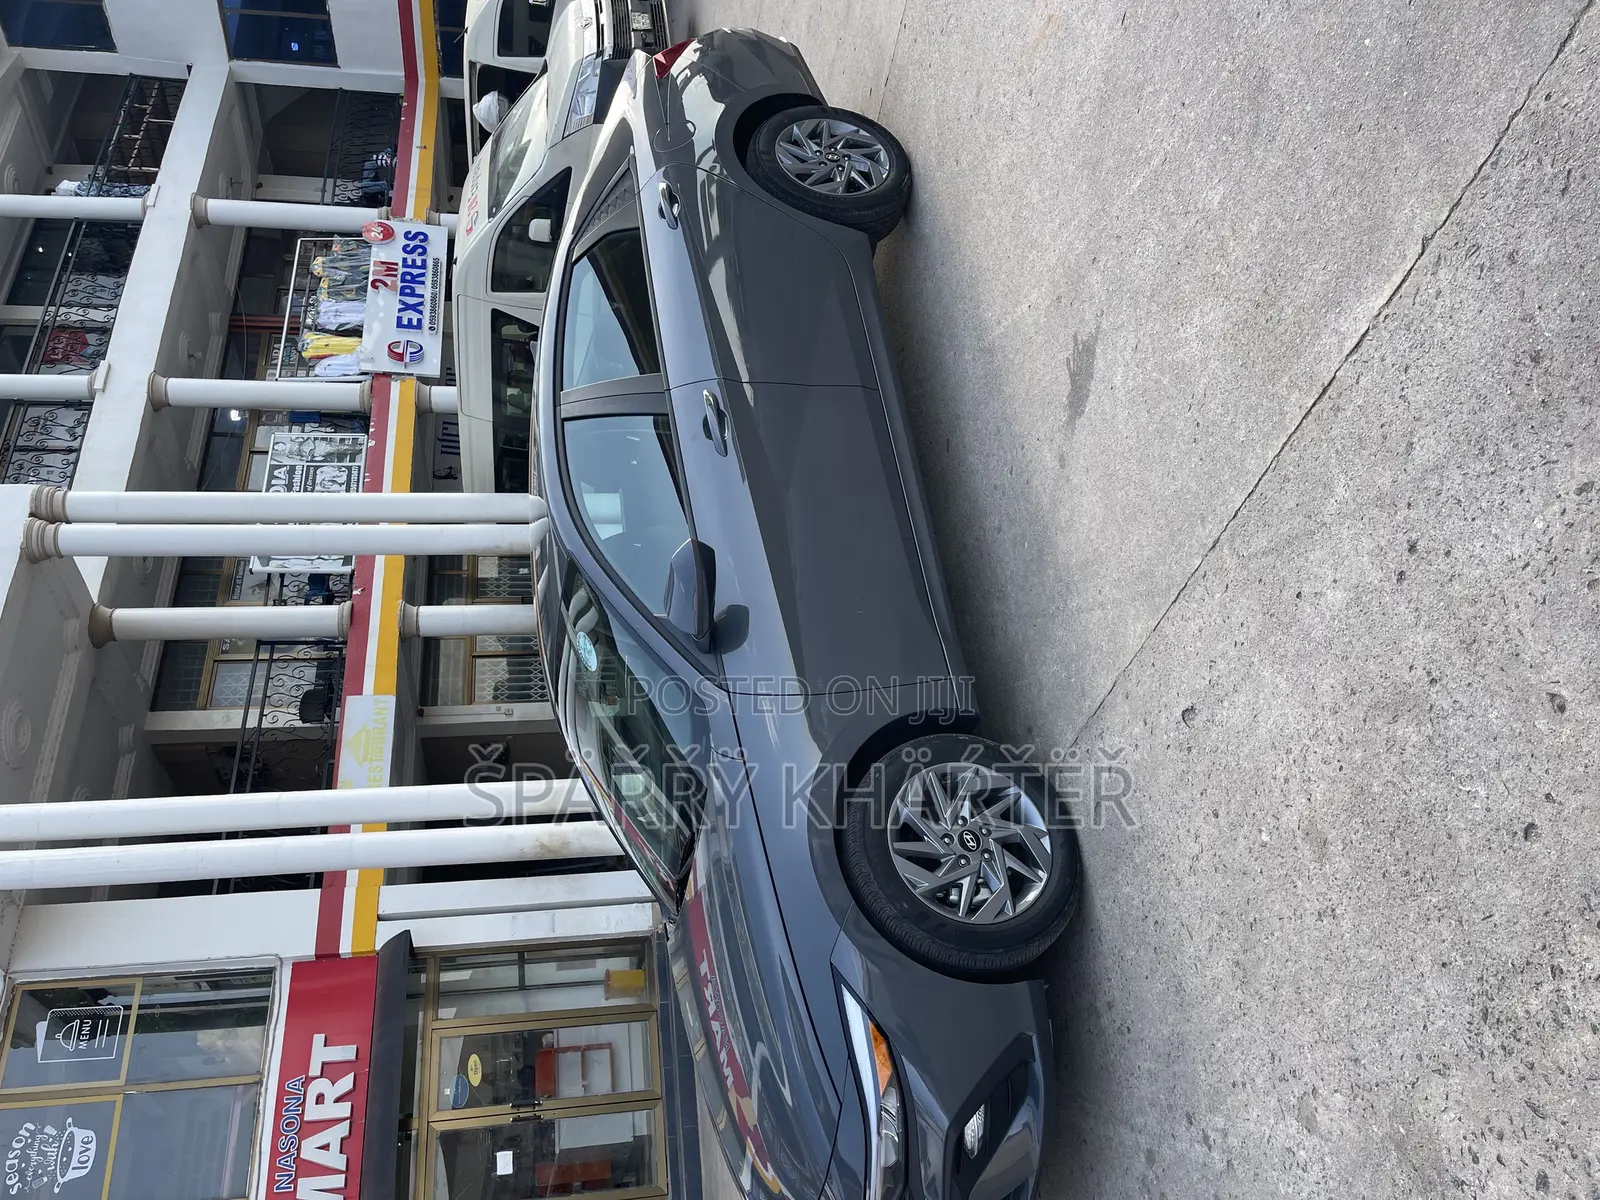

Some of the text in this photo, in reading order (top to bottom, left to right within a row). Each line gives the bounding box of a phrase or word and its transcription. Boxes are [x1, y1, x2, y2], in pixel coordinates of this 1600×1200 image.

[370, 226, 384, 239] 24
[370, 260, 399, 293] 2M
[395, 230, 429, 331] EXPRESS
[78, 1019, 92, 1050] MENU
[274, 1075, 305, 1193] NASONA
[5, 1122, 36, 1195] season
[25, 1133, 48, 1182] everything
[40, 1140, 59, 1171] with
[71, 1135, 94, 1171] love
